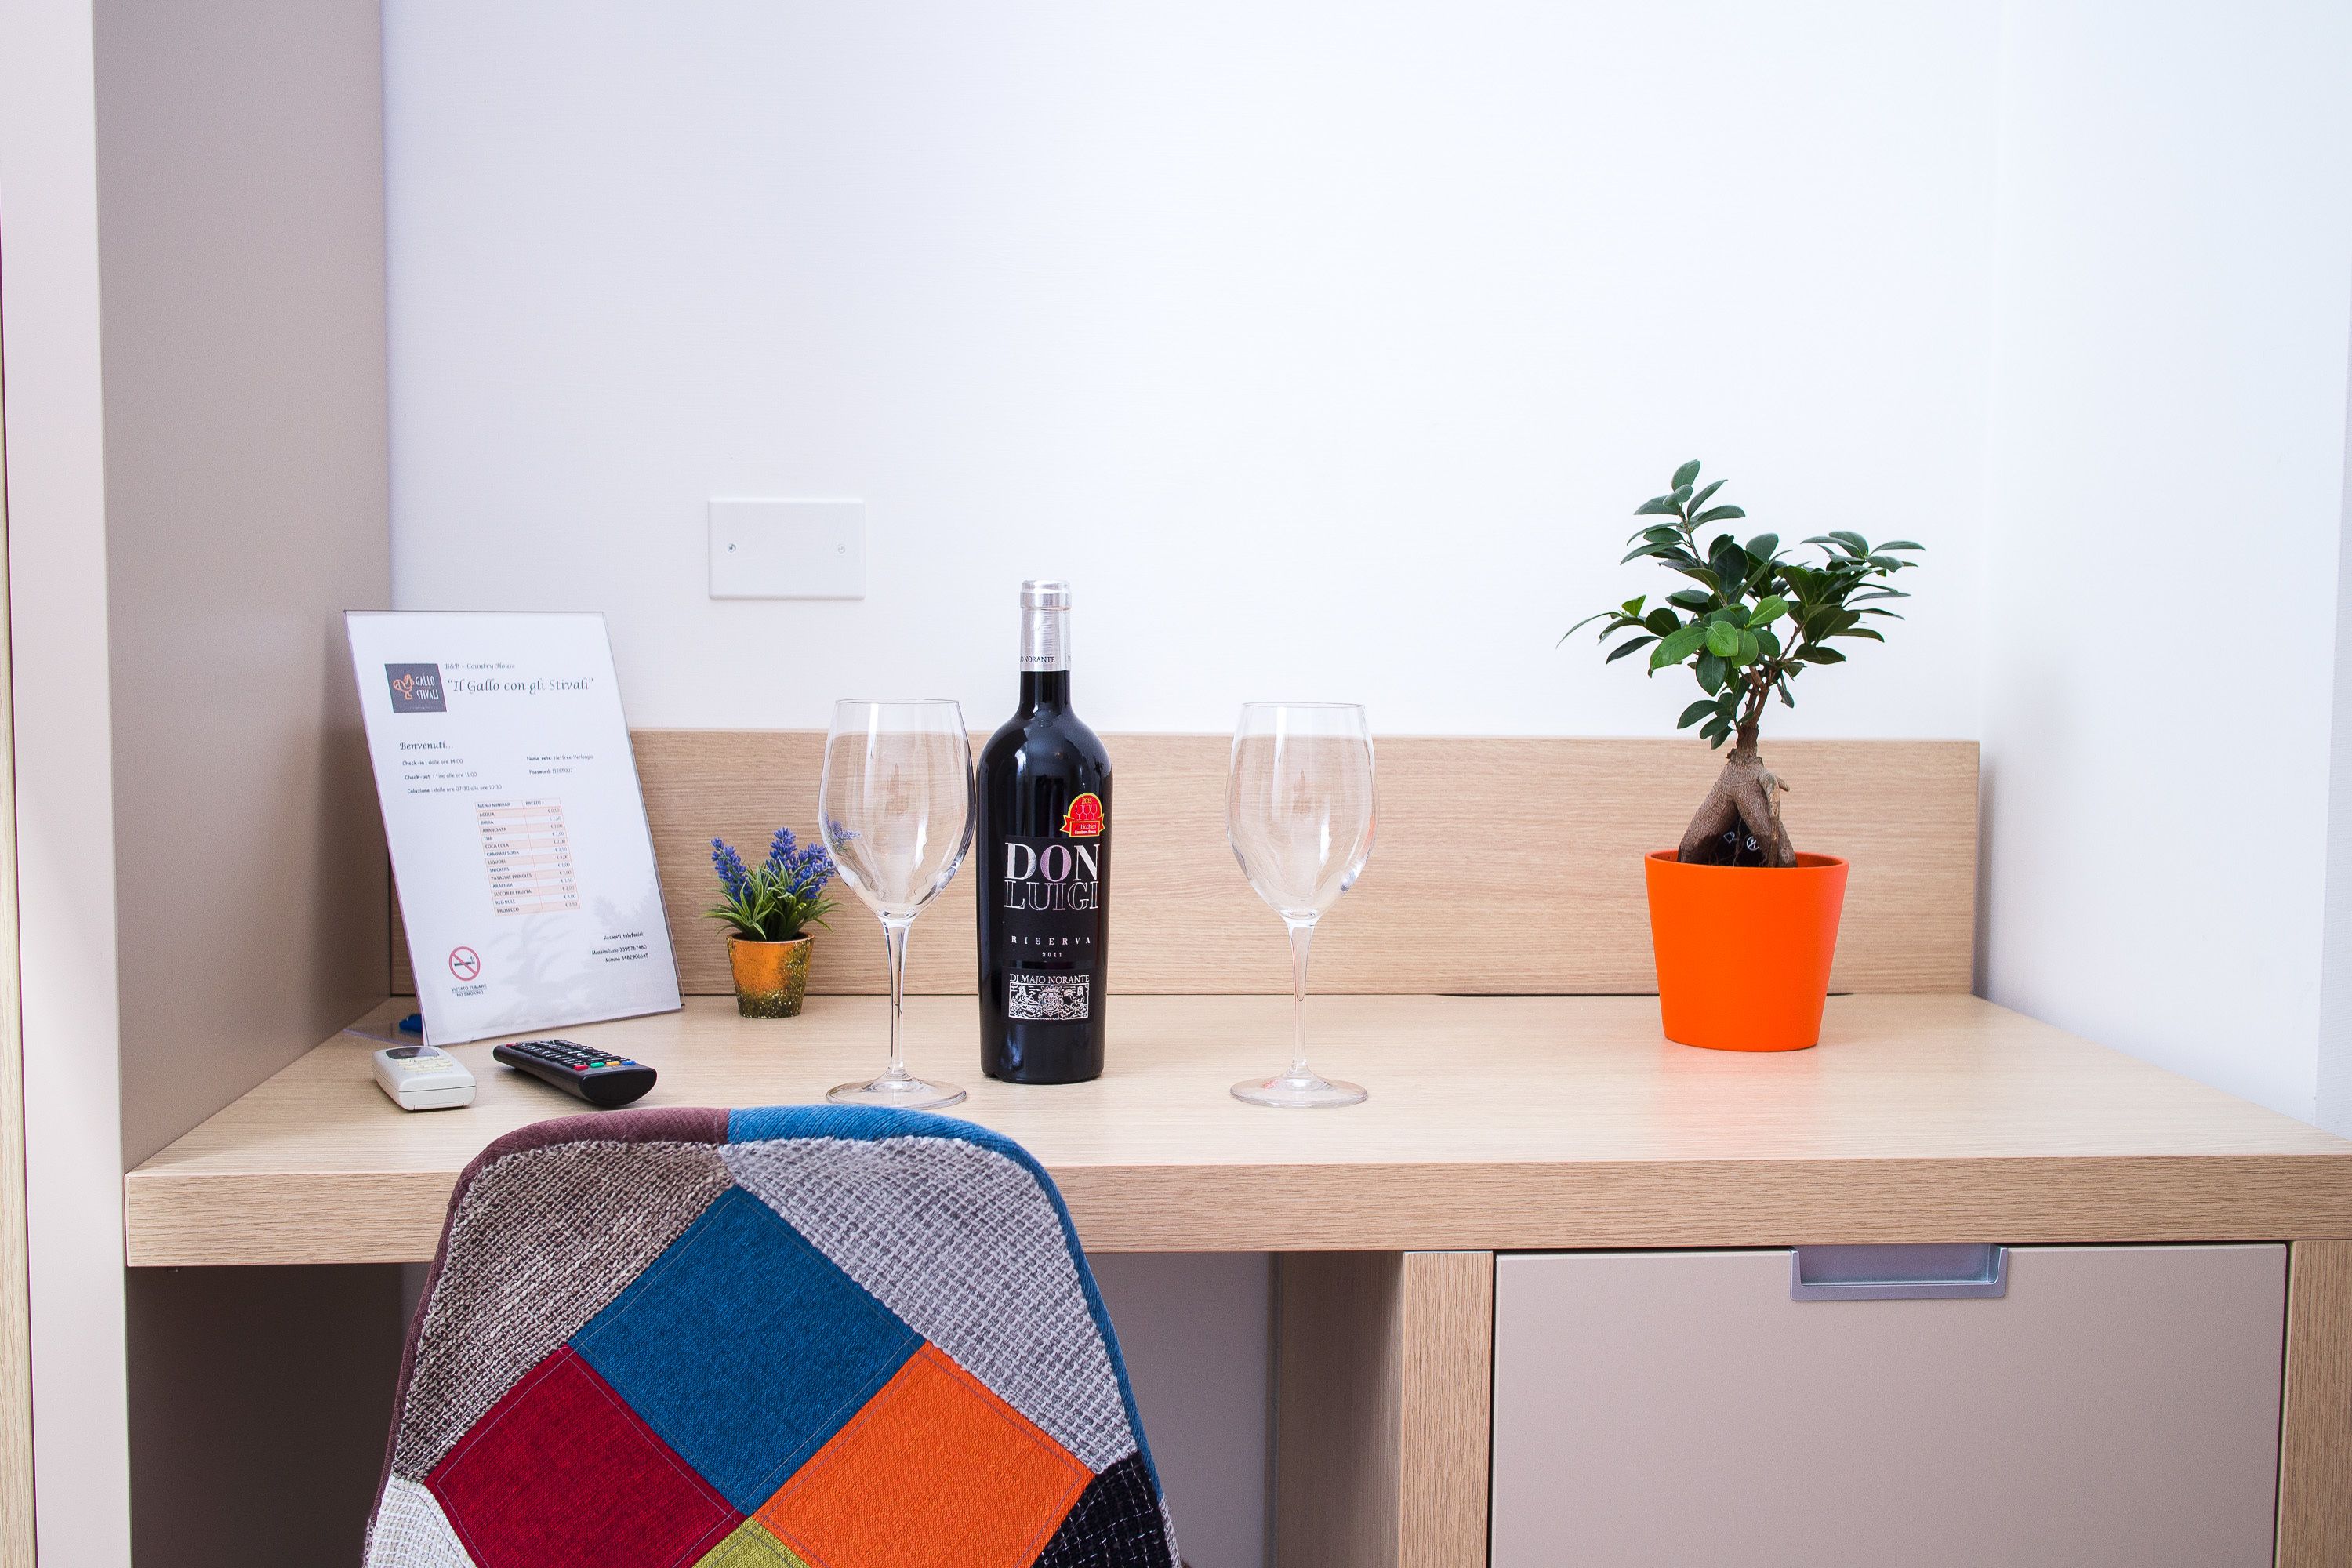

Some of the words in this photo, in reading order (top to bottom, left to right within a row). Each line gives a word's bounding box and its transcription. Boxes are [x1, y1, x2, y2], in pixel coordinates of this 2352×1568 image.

[466, 662, 494, 671] Country
[415, 675, 435, 686] GALLO
[467, 679, 499, 694] Gallo
[504, 681, 525, 691] con
[530, 678, 545, 695] gli
[416, 689, 439, 701] STIVALI
[1004, 842, 1100, 883] DON
[1004, 879, 1099, 911] LUIGI
[1011, 935, 1091, 946] RISERVA
[1009, 973, 1019, 982] DI
[1021, 975, 1046, 984] MAJO
[1047, 975, 1090, 984] NORANTE
